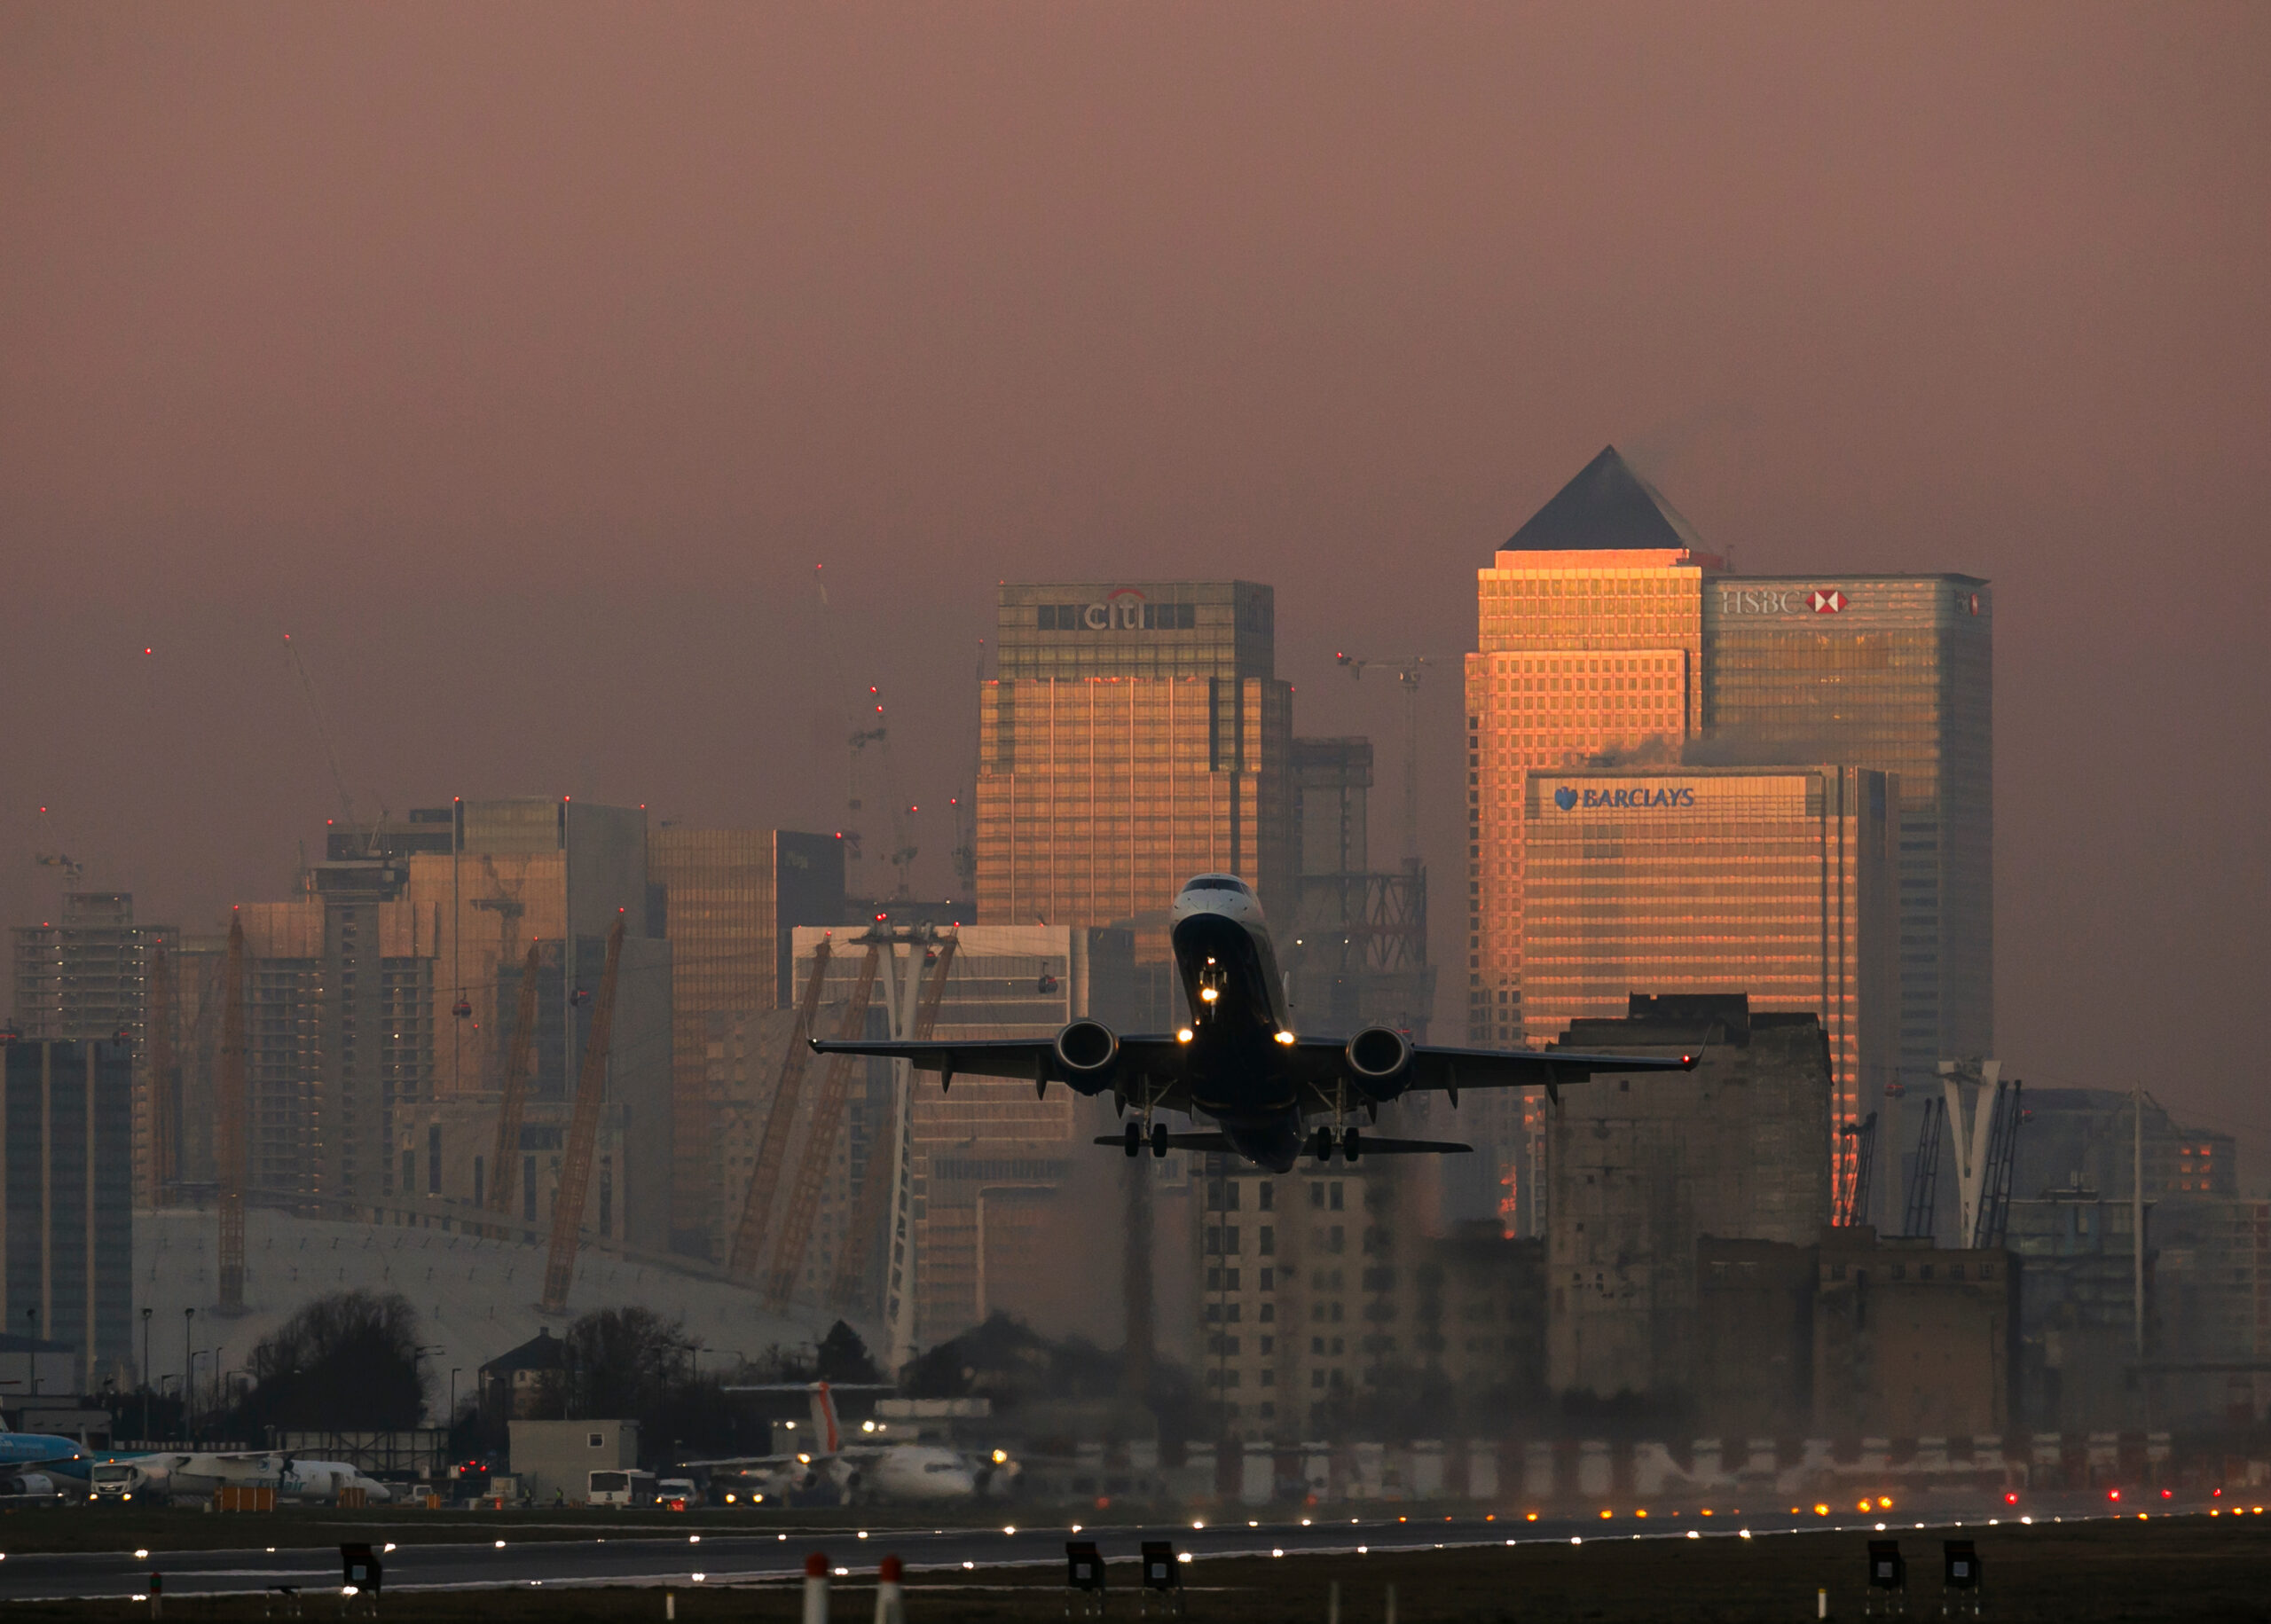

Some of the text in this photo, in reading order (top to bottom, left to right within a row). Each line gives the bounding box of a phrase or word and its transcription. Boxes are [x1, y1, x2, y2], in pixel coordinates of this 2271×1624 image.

[1722, 590, 1801, 615] HSBC
[1084, 601, 1145, 630] citi
[1583, 788, 1694, 808] BARCLAYS
